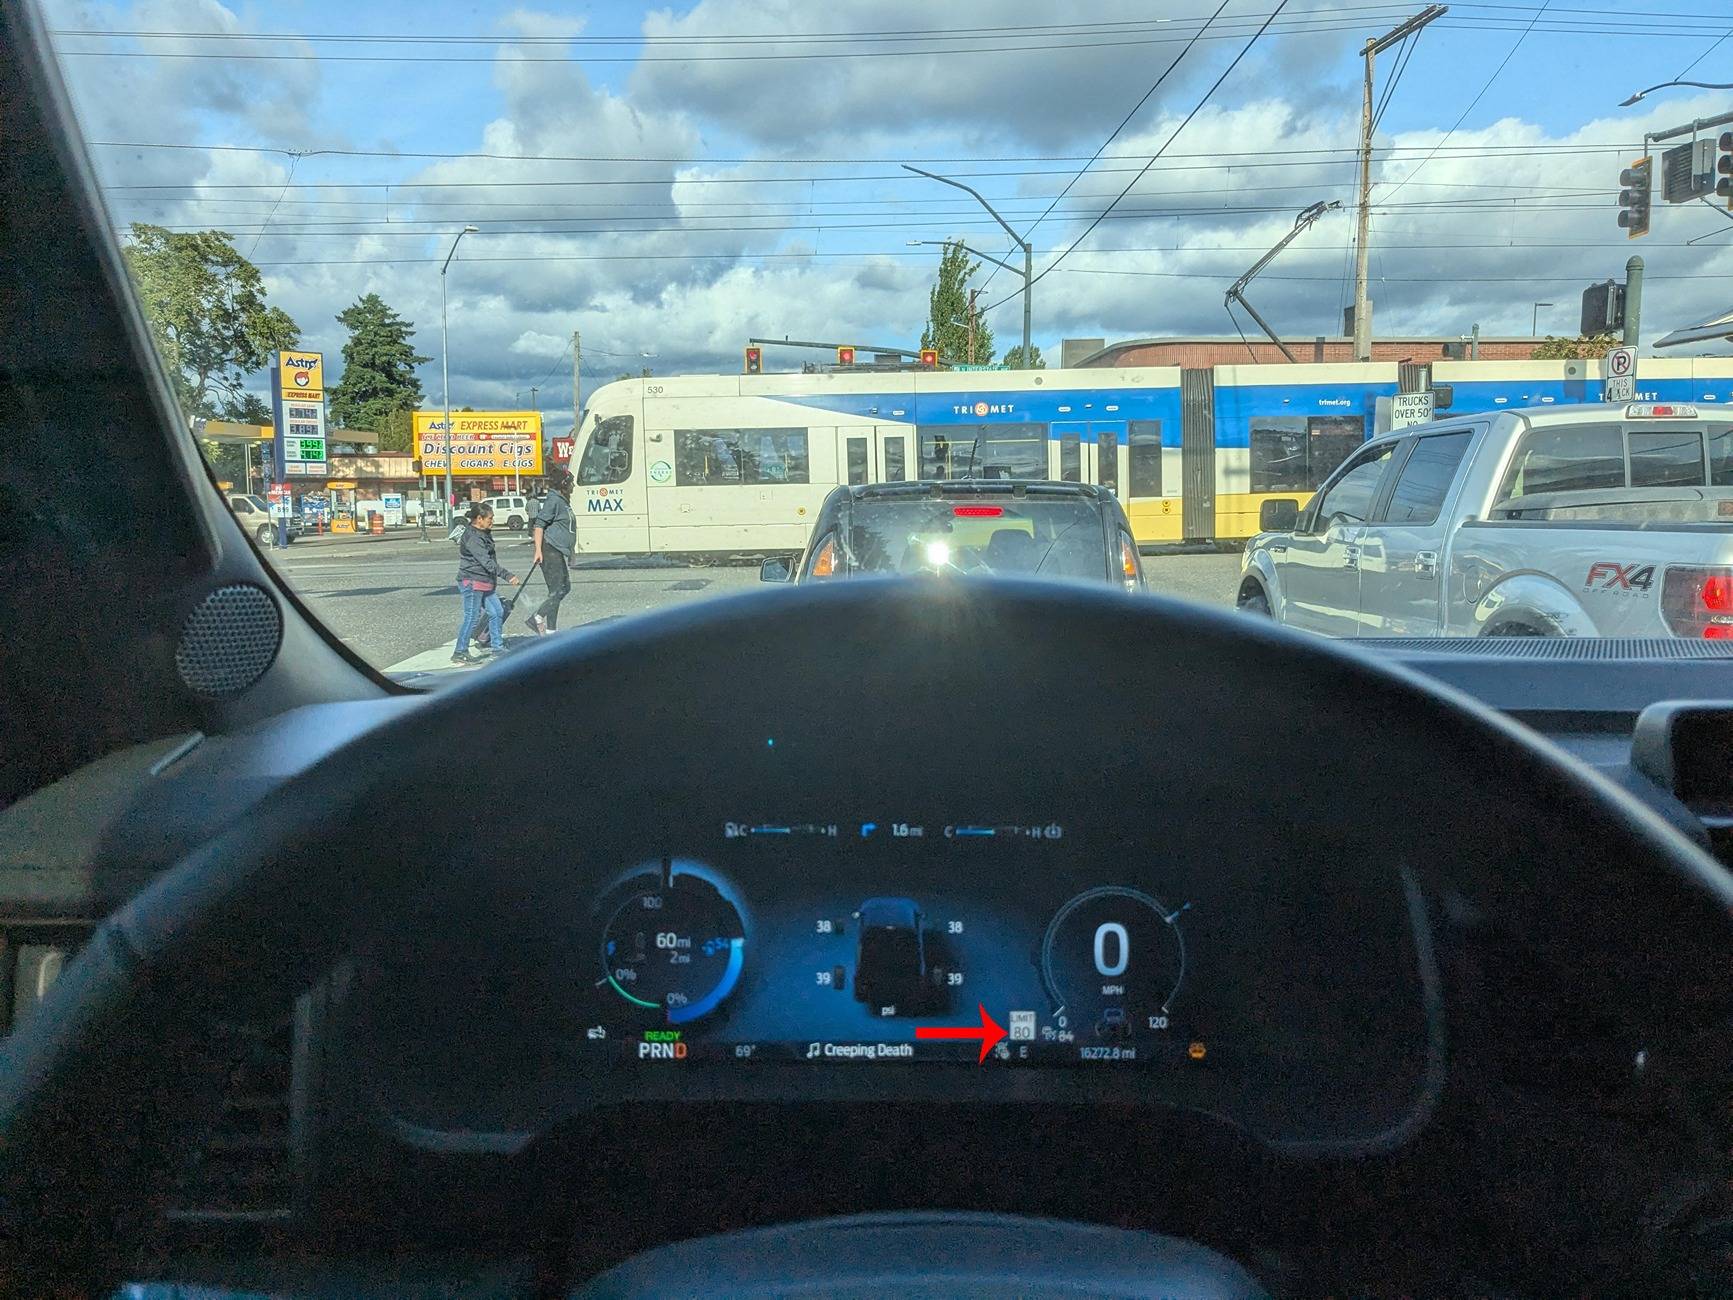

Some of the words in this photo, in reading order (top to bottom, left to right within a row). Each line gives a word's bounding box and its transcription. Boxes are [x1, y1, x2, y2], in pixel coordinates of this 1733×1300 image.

[1612, 378, 1629, 388] THIS
[647, 386, 664, 394] 530
[1318, 399, 1351, 407] trimet.org
[1398, 396, 1429, 406] TRUCKS
[1394, 409, 1415, 419] OVER
[1417, 407, 1432, 417] 50'
[429, 422, 455, 430] Asto
[460, 420, 499, 431] EXPRESS
[500, 420, 528, 430] MART
[424, 443, 494, 454] Discount
[499, 443, 532, 456] Cigs
[460, 460, 494, 468] CIGARS
[503, 459, 533, 468] E-CIGS
[587, 499, 624, 512] MAX
[1585, 561, 1657, 592] FX4
[1613, 591, 1649, 599] ROAD
[816, 919, 832, 934] 38
[948, 920, 963, 934] 38
[1092, 922, 1130, 976] 0
[615, 968, 637, 981] 0%
[816, 971, 831, 985] 39
[947, 971, 963, 985] 39
[1102, 984, 1124, 995] MPH
[666, 992, 688, 1005] 0%
[881, 1004, 896, 1017] psi
[1009, 1014, 1033, 1023] LIMIT
[1058, 1015, 1067, 1027] 0
[1148, 1016, 1168, 1029] 120
[644, 1030, 681, 1042] READY
[1014, 1026, 1030, 1039] 80
[824, 1043, 876, 1058] Creeping
[877, 1043, 913, 1057] Death
[1080, 1047, 1120, 1060] 16272.8
[1121, 1047, 1136, 1060] mi
